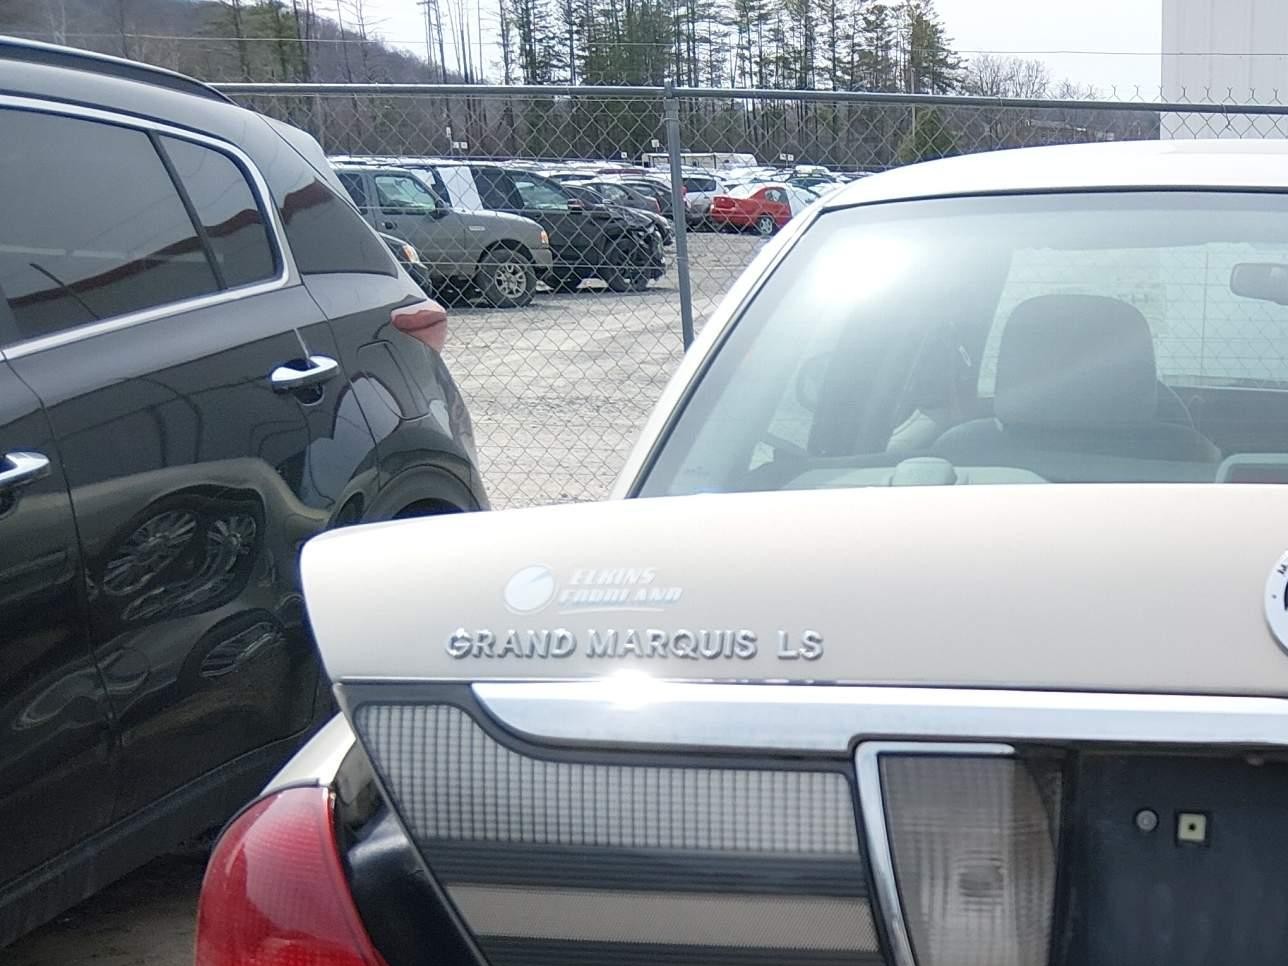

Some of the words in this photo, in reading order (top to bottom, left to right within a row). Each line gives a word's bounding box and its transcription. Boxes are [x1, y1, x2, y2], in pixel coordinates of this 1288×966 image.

[569, 567, 657, 585] ELKINS
[446, 628, 577, 660] GRAND
[585, 629, 758, 660] MARQUIS
[777, 630, 824, 660] LS
